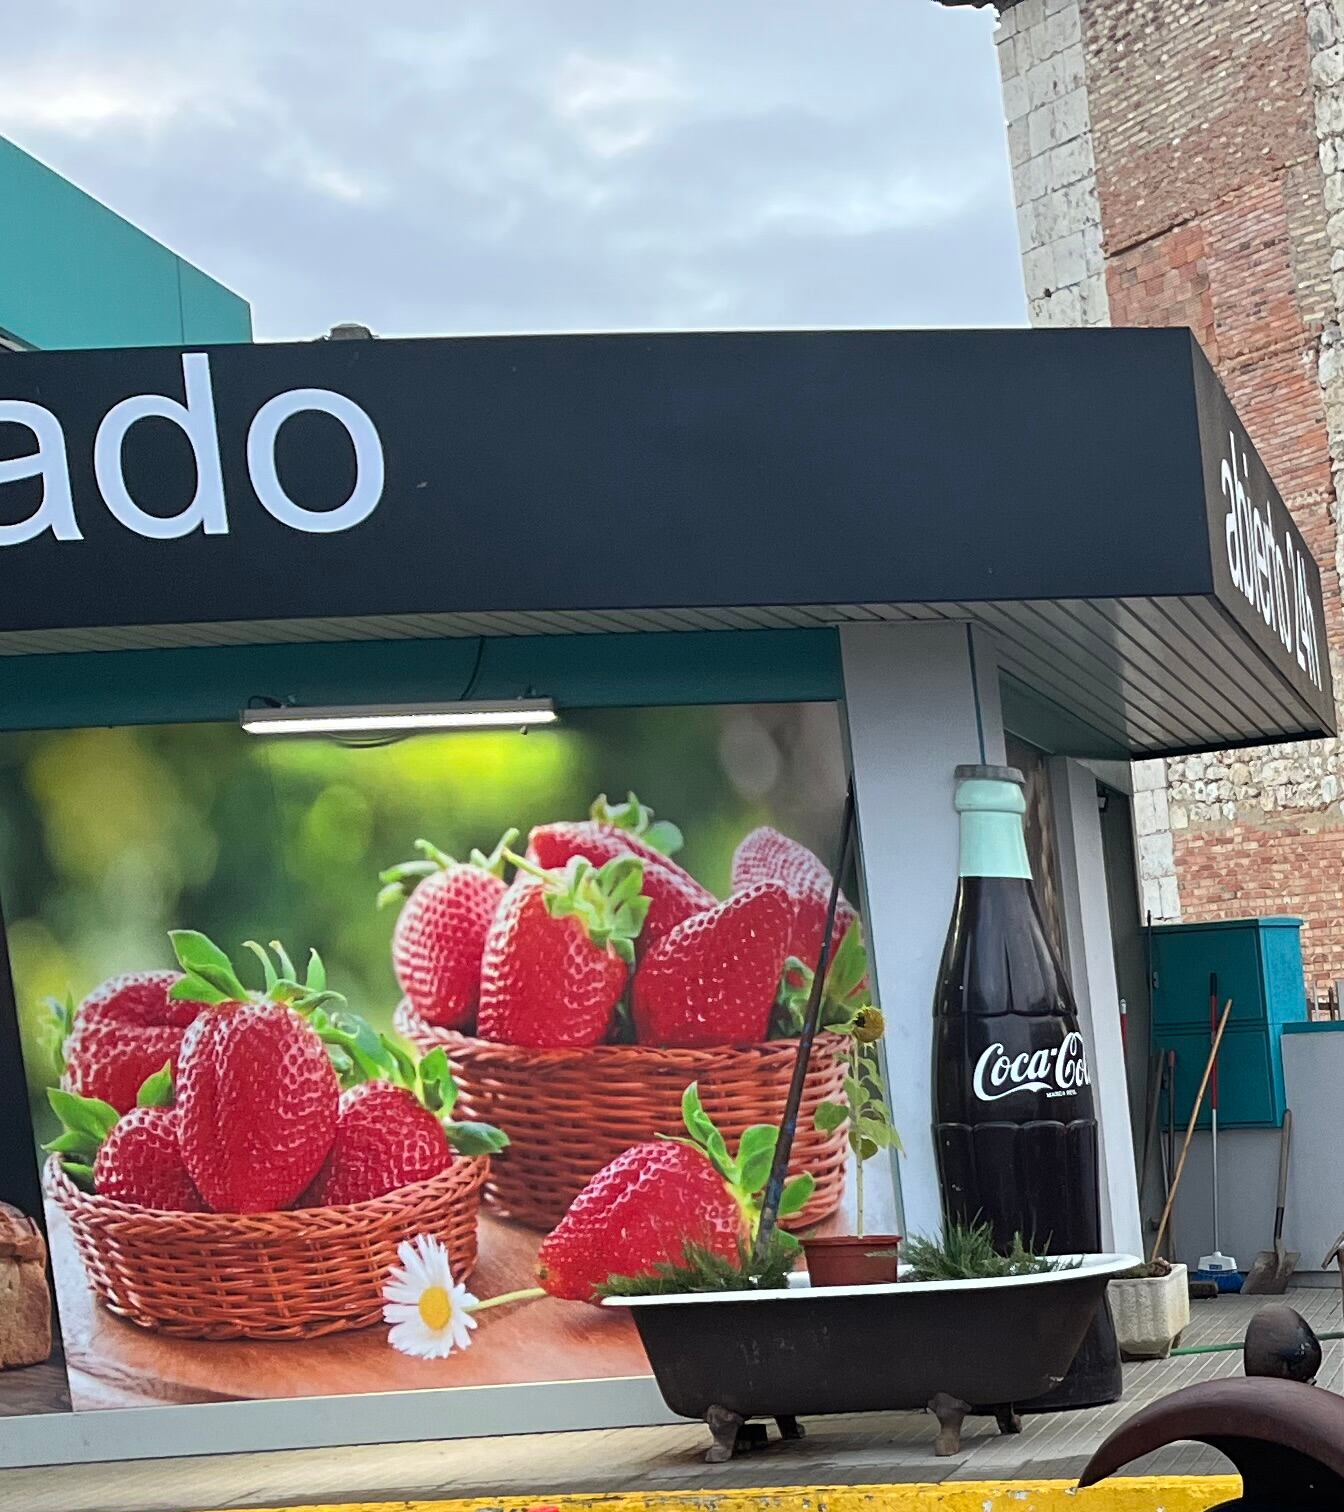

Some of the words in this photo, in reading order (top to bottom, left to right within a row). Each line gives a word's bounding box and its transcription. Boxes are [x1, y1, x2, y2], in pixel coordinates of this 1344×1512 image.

[0, 352, 386, 546] ado
[1221, 430, 1291, 654] abierto
[1286, 531, 1323, 692] 24h
[973, 1031, 1091, 1101] Coca-Col
